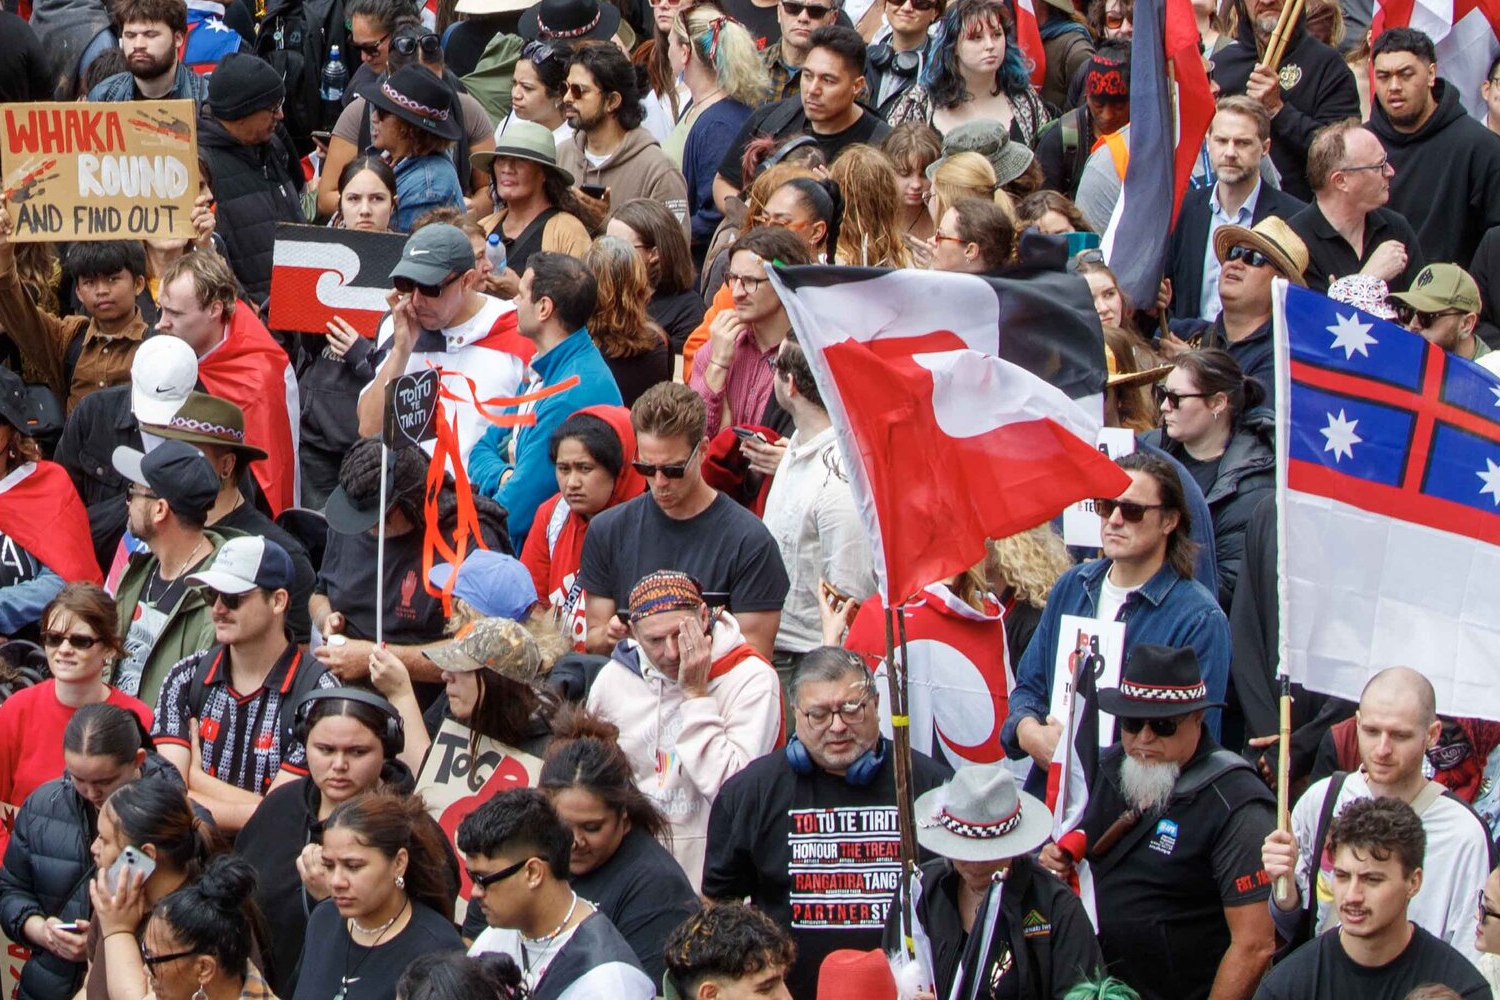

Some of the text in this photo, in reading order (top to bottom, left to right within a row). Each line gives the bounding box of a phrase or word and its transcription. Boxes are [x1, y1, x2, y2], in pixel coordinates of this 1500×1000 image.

[5, 110, 126, 154] WHAKA
[78, 153, 189, 198] ROUND
[15, 204, 180, 235] AND FIND OUT
[410, 401, 421, 411] TE
[400, 413, 427, 430] TIRITI
[837, 811, 856, 831] TE
[859, 810, 898, 830] TIRIT
[793, 841, 900, 859] HONOUR THE TREAT
[792, 902, 891, 921] PARTNERSH
